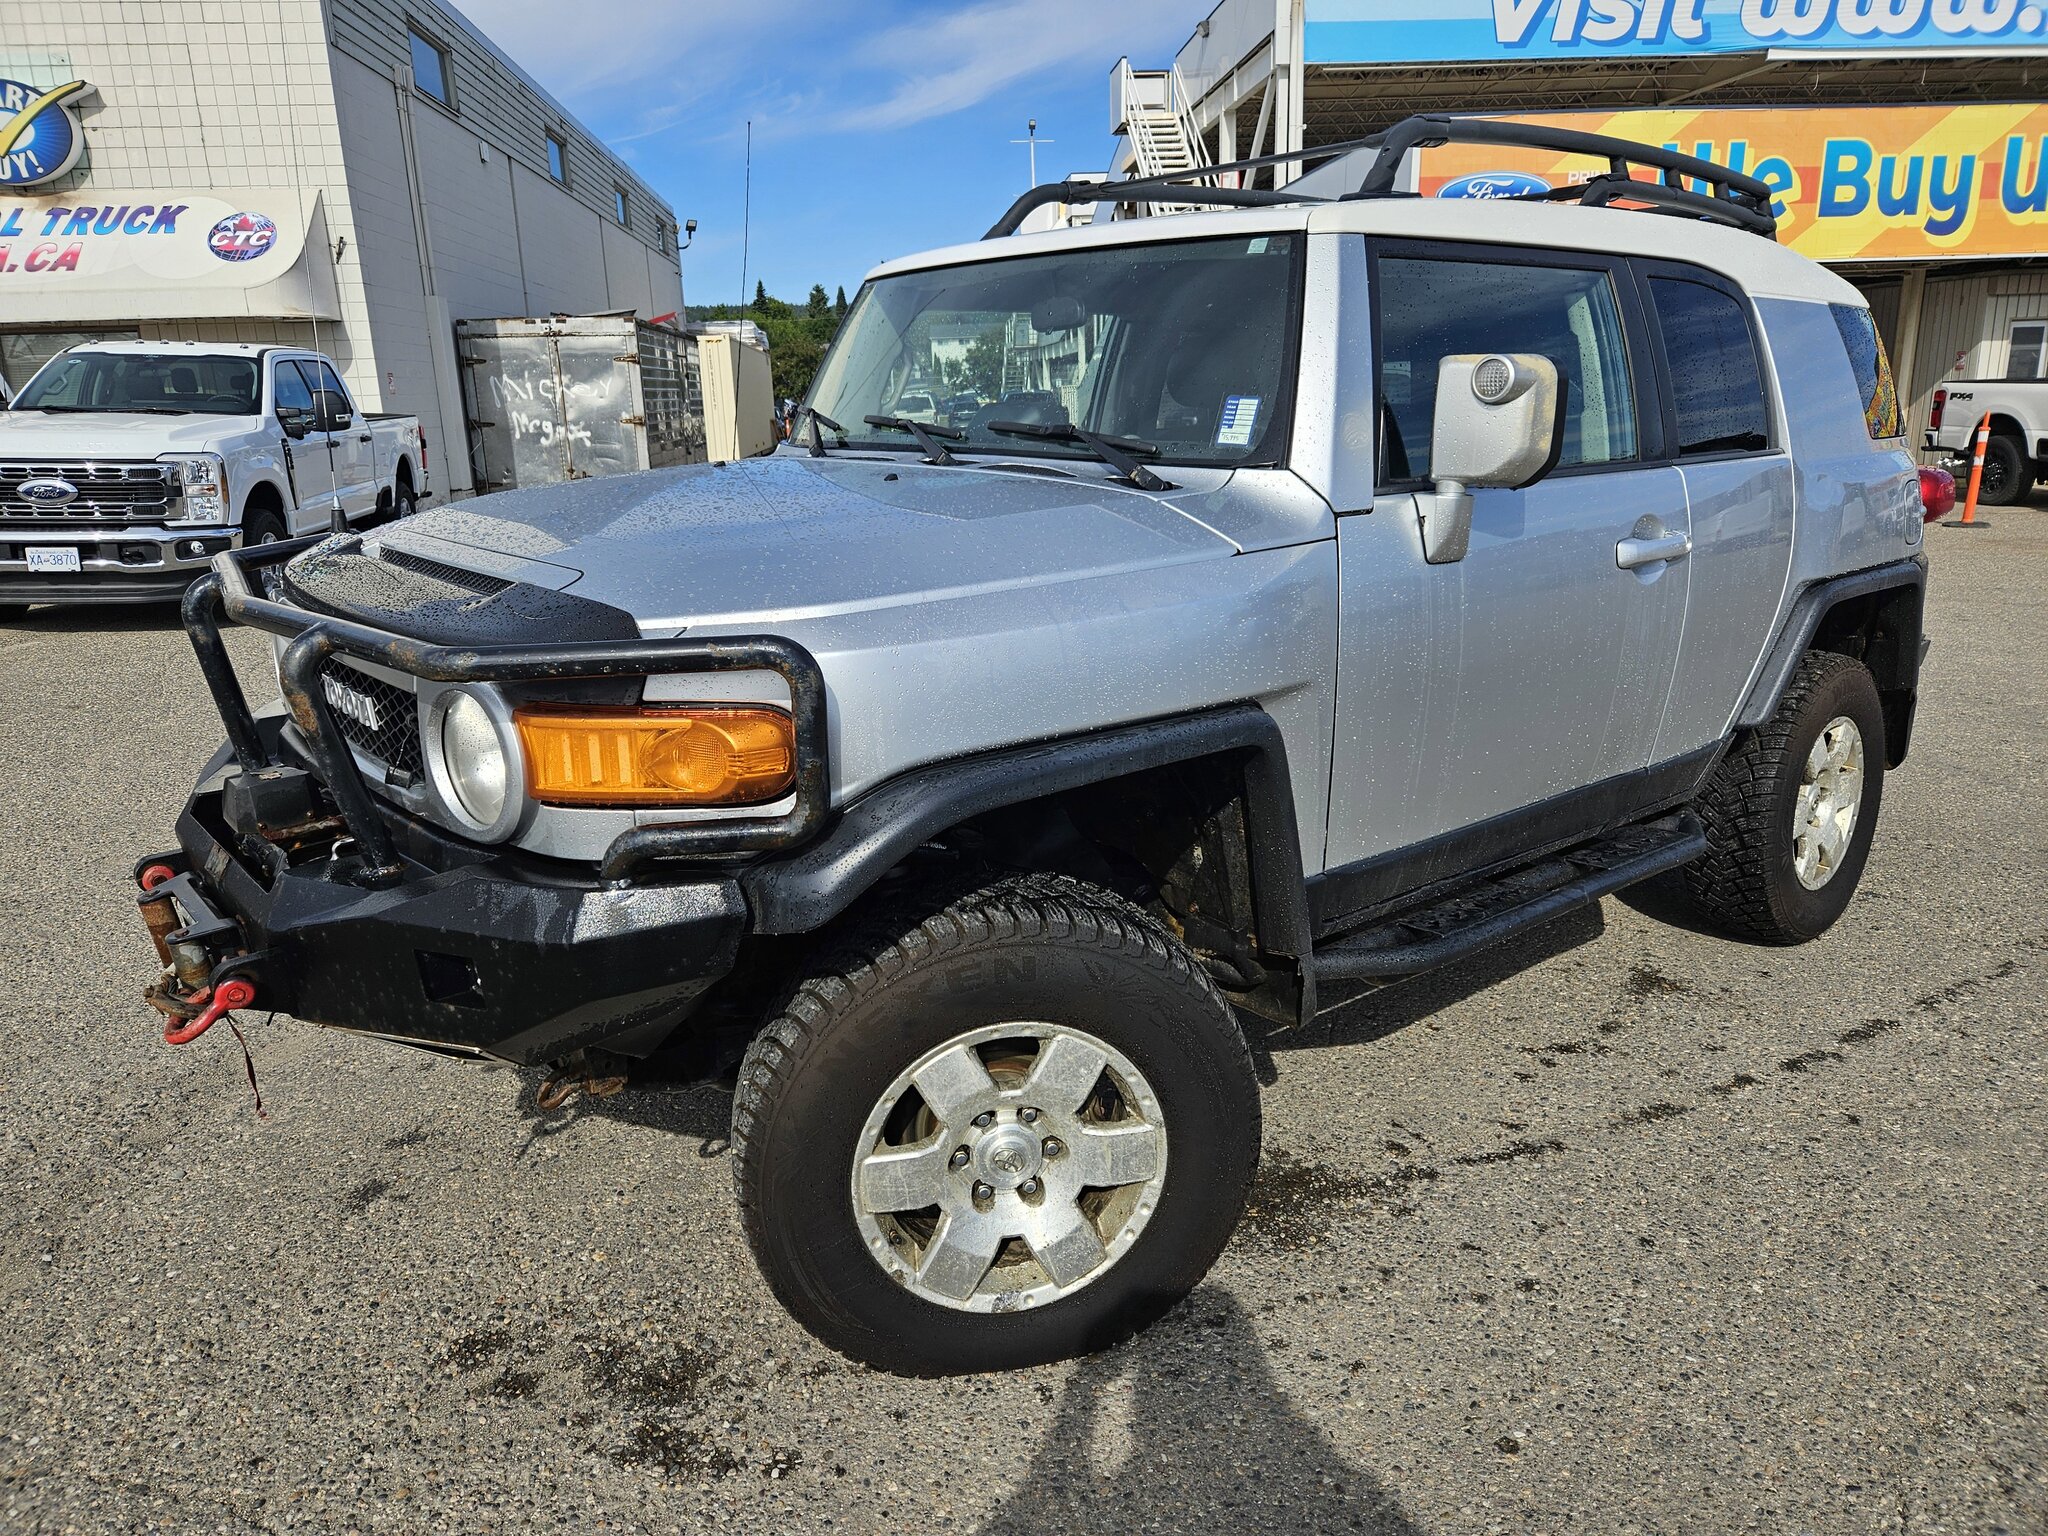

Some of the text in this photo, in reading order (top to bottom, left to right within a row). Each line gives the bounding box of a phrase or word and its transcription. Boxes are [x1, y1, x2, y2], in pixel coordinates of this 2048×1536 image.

[1740, 0, 2048, 36] www.
[1818, 139, 1976, 236] Buy
[0, 205, 189, 237] L TRUCK
[211, 230, 271, 246] CTC
[32, 486, 60, 498] Ford
